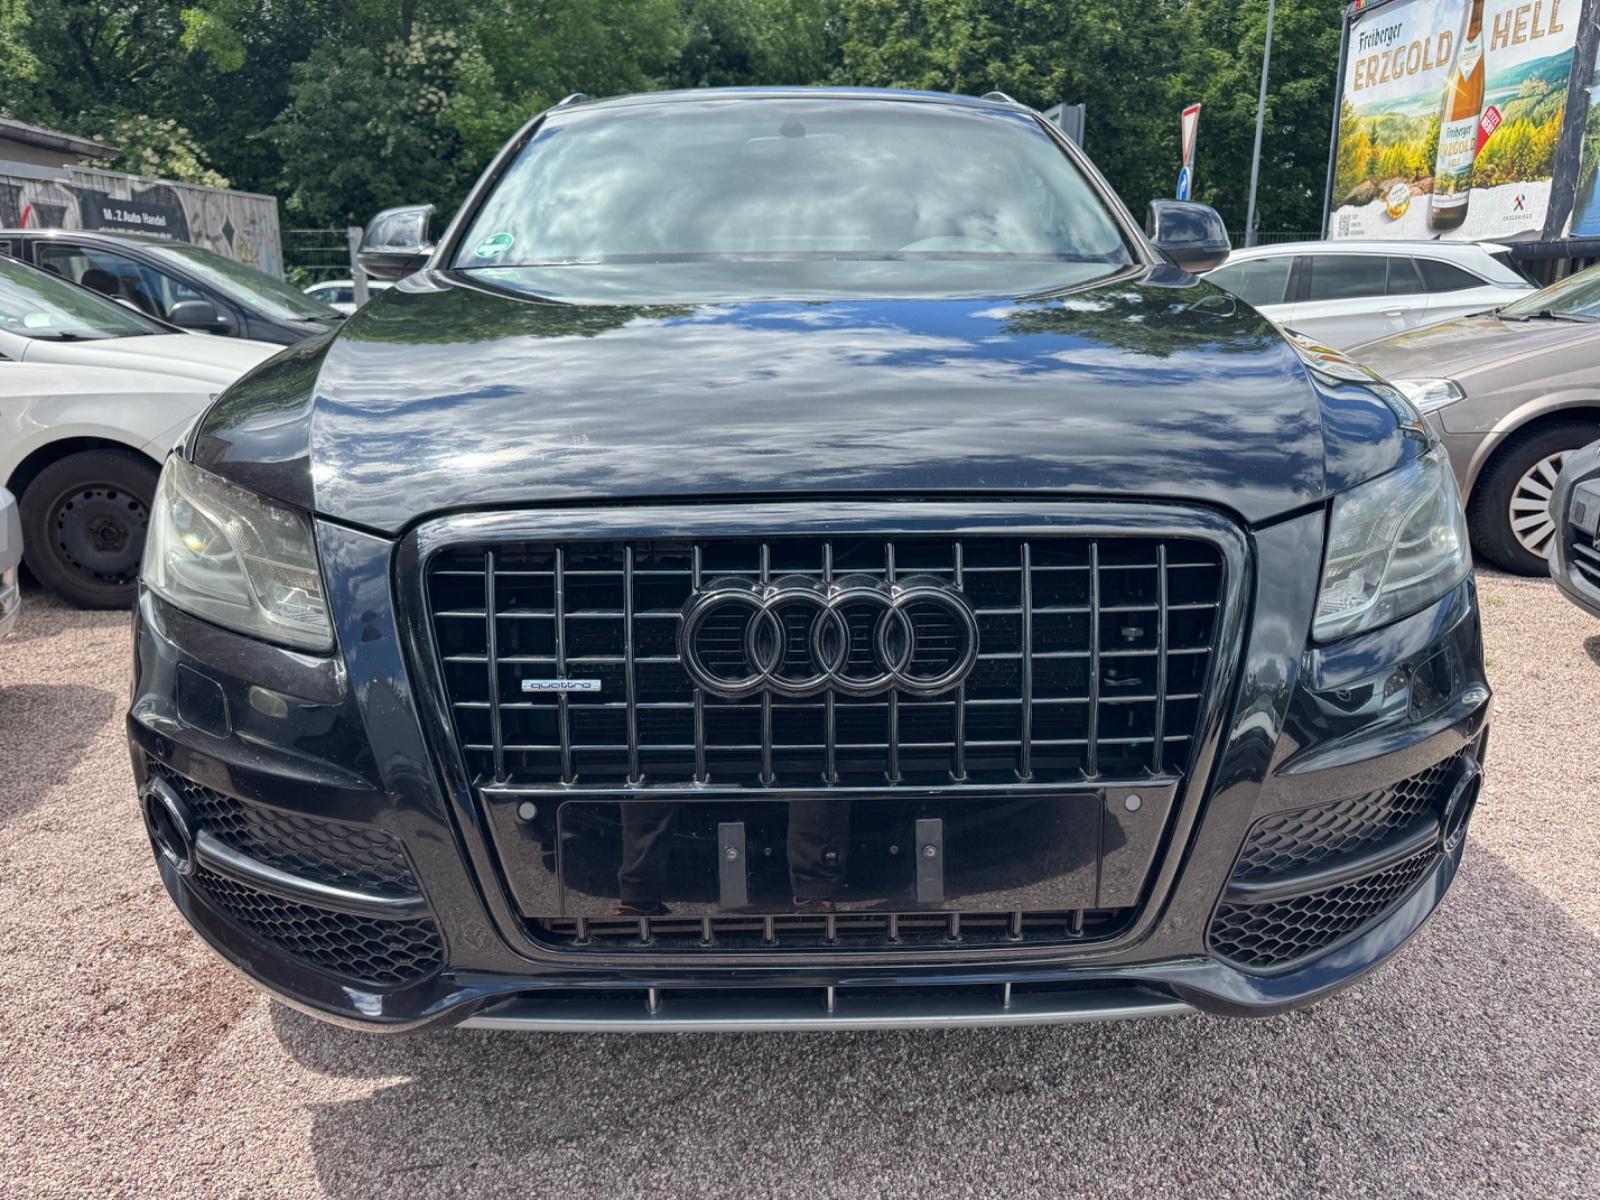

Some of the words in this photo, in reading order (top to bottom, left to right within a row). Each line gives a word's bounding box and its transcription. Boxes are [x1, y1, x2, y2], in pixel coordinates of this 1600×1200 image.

[1353, 30, 1453, 91] ERZGOLD
[1490, 0, 1563, 51] HELL
[1359, 22, 1402, 53] Freiberger
[123, 210, 142, 224] Auto
[141, 212, 167, 226] Handel
[530, 681, 591, 689] quattro
